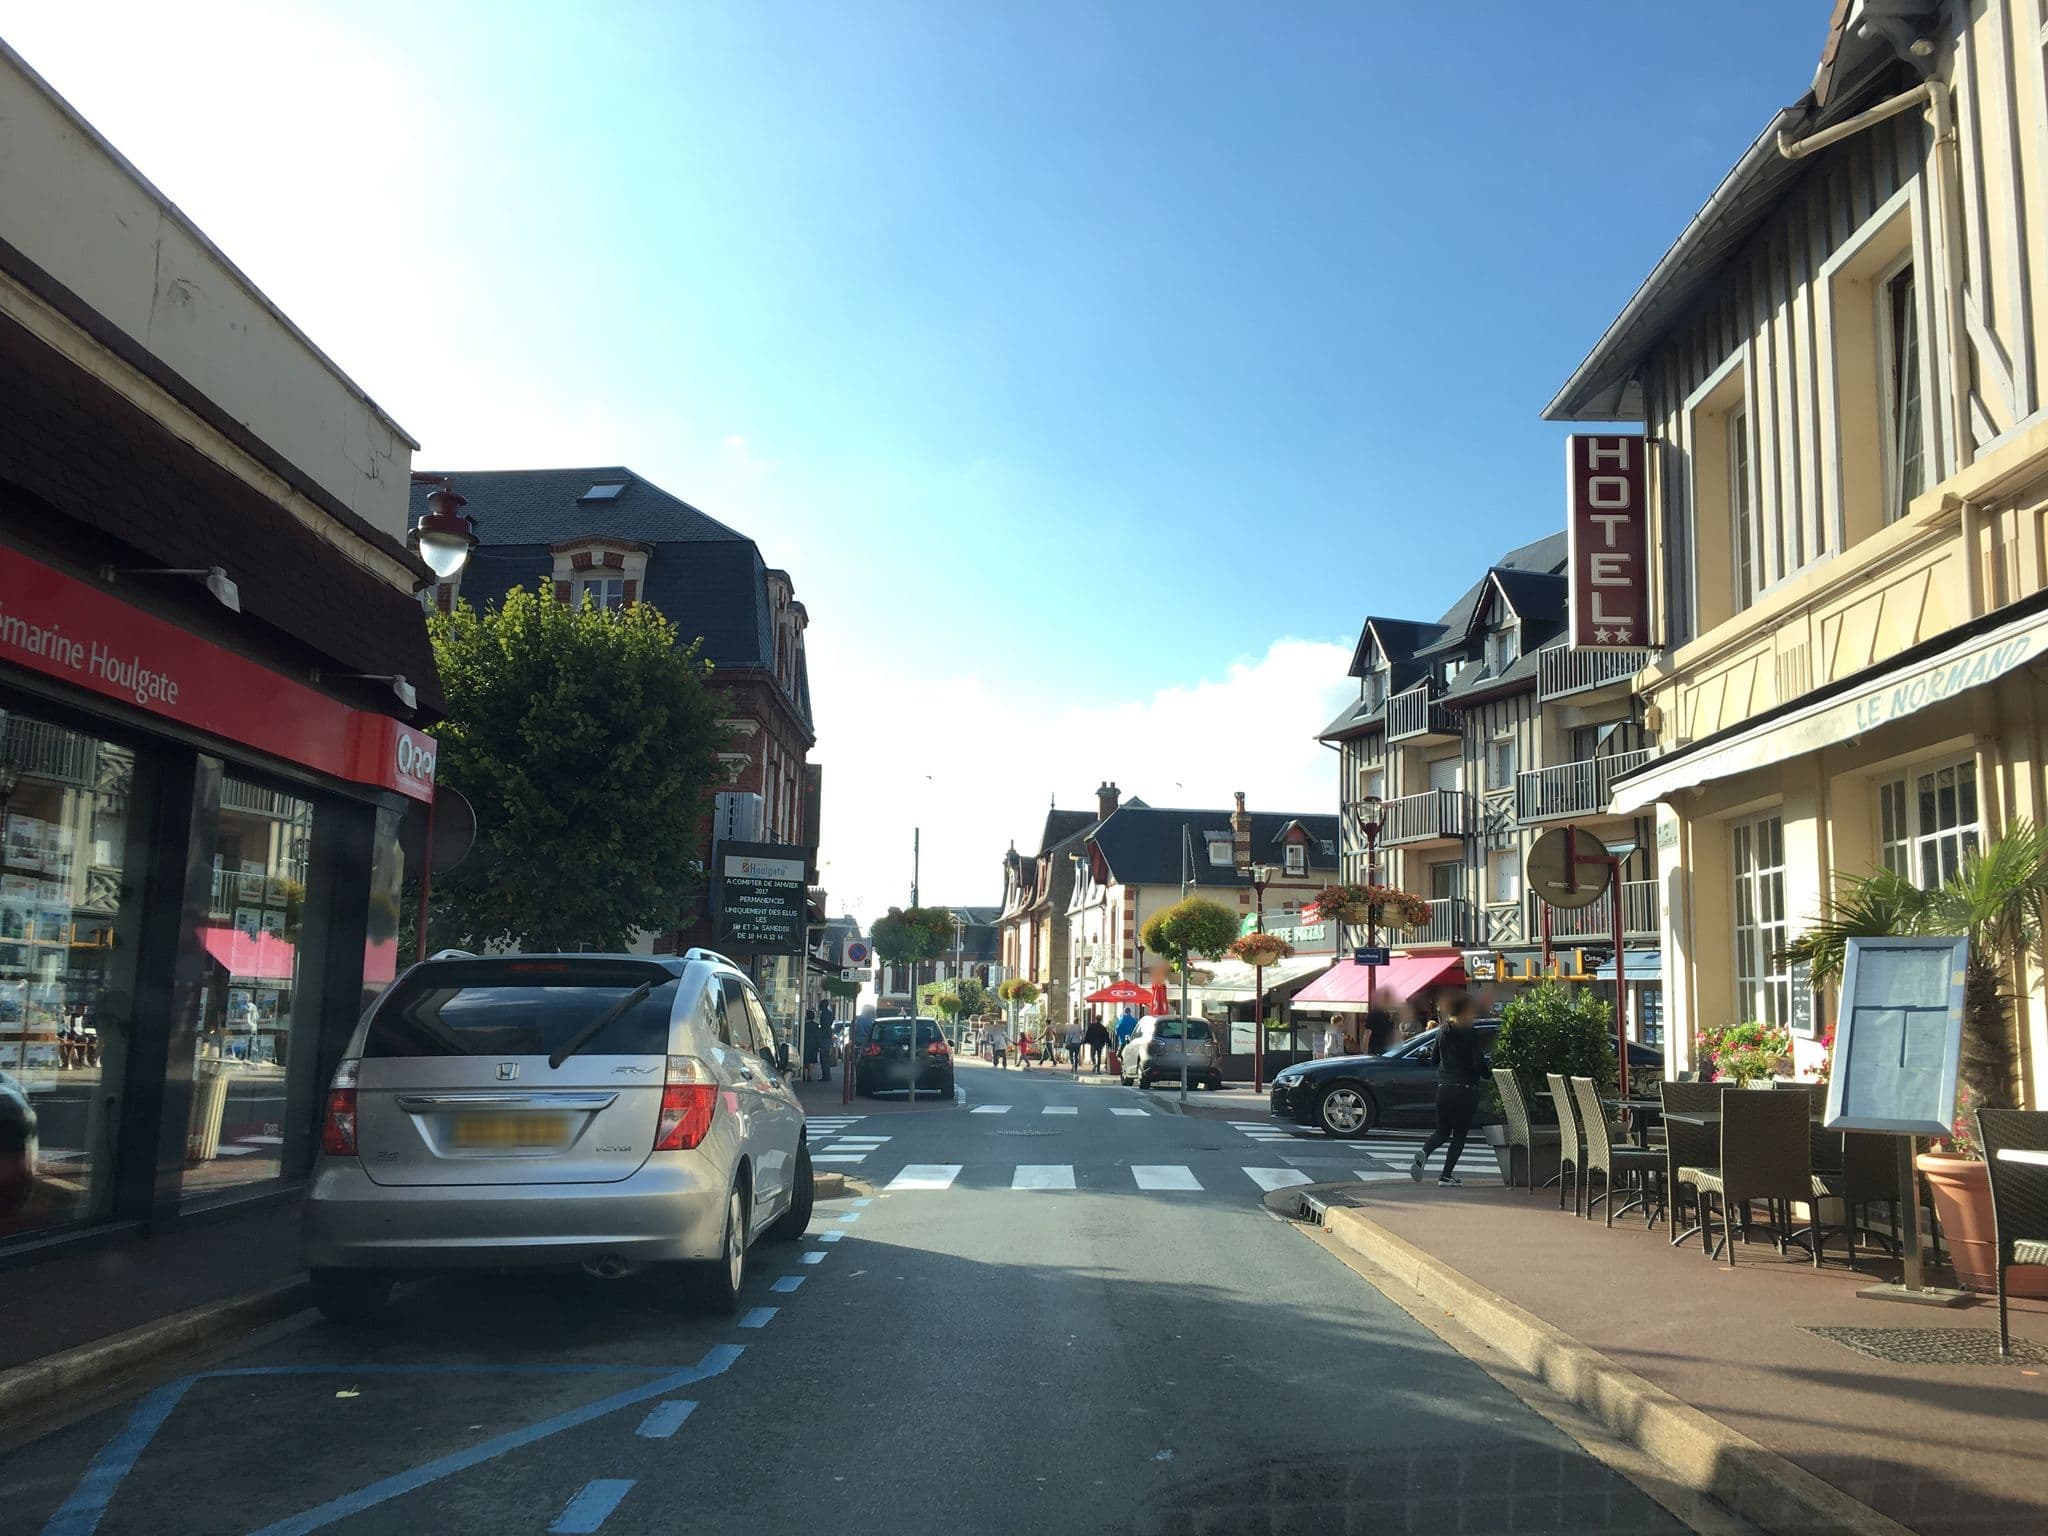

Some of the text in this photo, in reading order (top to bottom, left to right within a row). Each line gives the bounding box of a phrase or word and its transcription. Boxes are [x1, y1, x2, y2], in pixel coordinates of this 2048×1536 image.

[1588, 437, 1633, 625] HOTEL
[0, 601, 178, 704] marine Houlgate
[1856, 636, 2031, 730] LE NORMAND
[750, 863, 786, 877] Houlgate
[732, 879, 763, 887] COMPTER
[774, 881, 799, 889] JANVIER
[739, 896, 785, 904] PERMANENCES
[725, 906, 767, 915] UNIQUEMENT
[782, 909, 798, 917] ELUS
